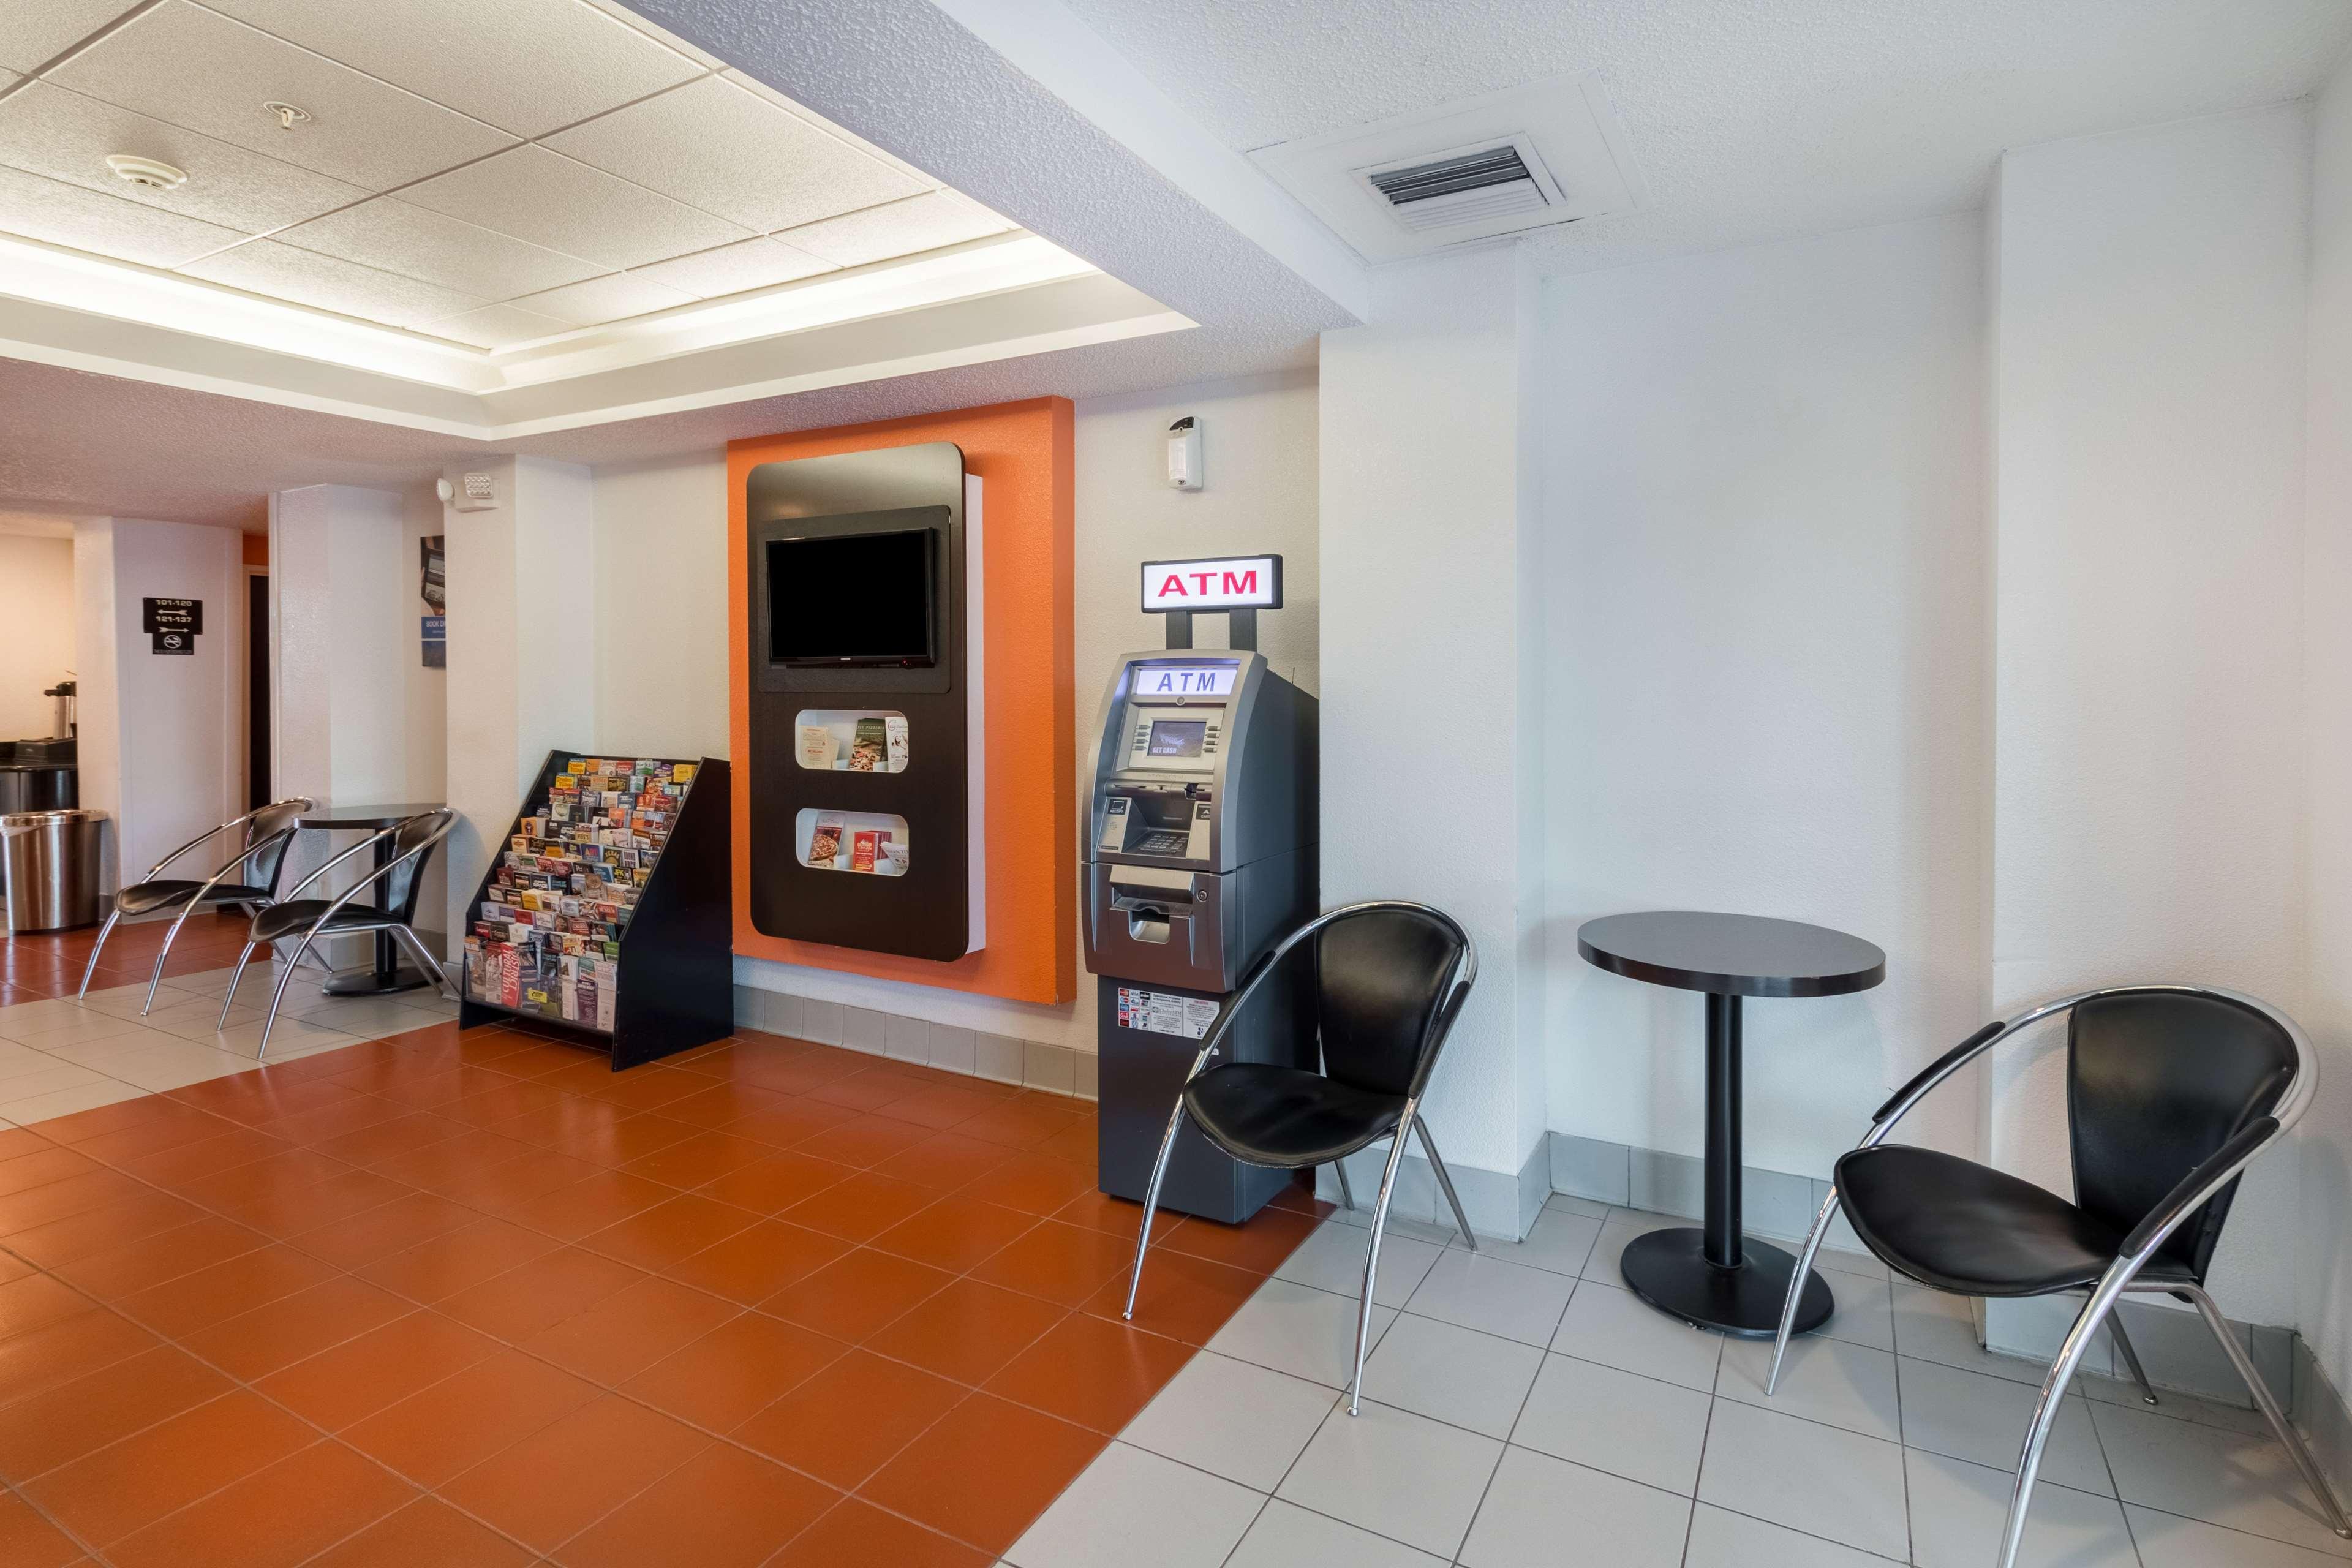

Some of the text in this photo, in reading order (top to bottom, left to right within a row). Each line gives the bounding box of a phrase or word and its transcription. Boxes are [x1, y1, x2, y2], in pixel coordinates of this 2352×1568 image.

[1158, 570, 1257, 597] ATM
[1156, 672, 1216, 692] ATM
[604, 850, 620, 859] TEXAS
[502, 949, 511, 993] CULTURAL
